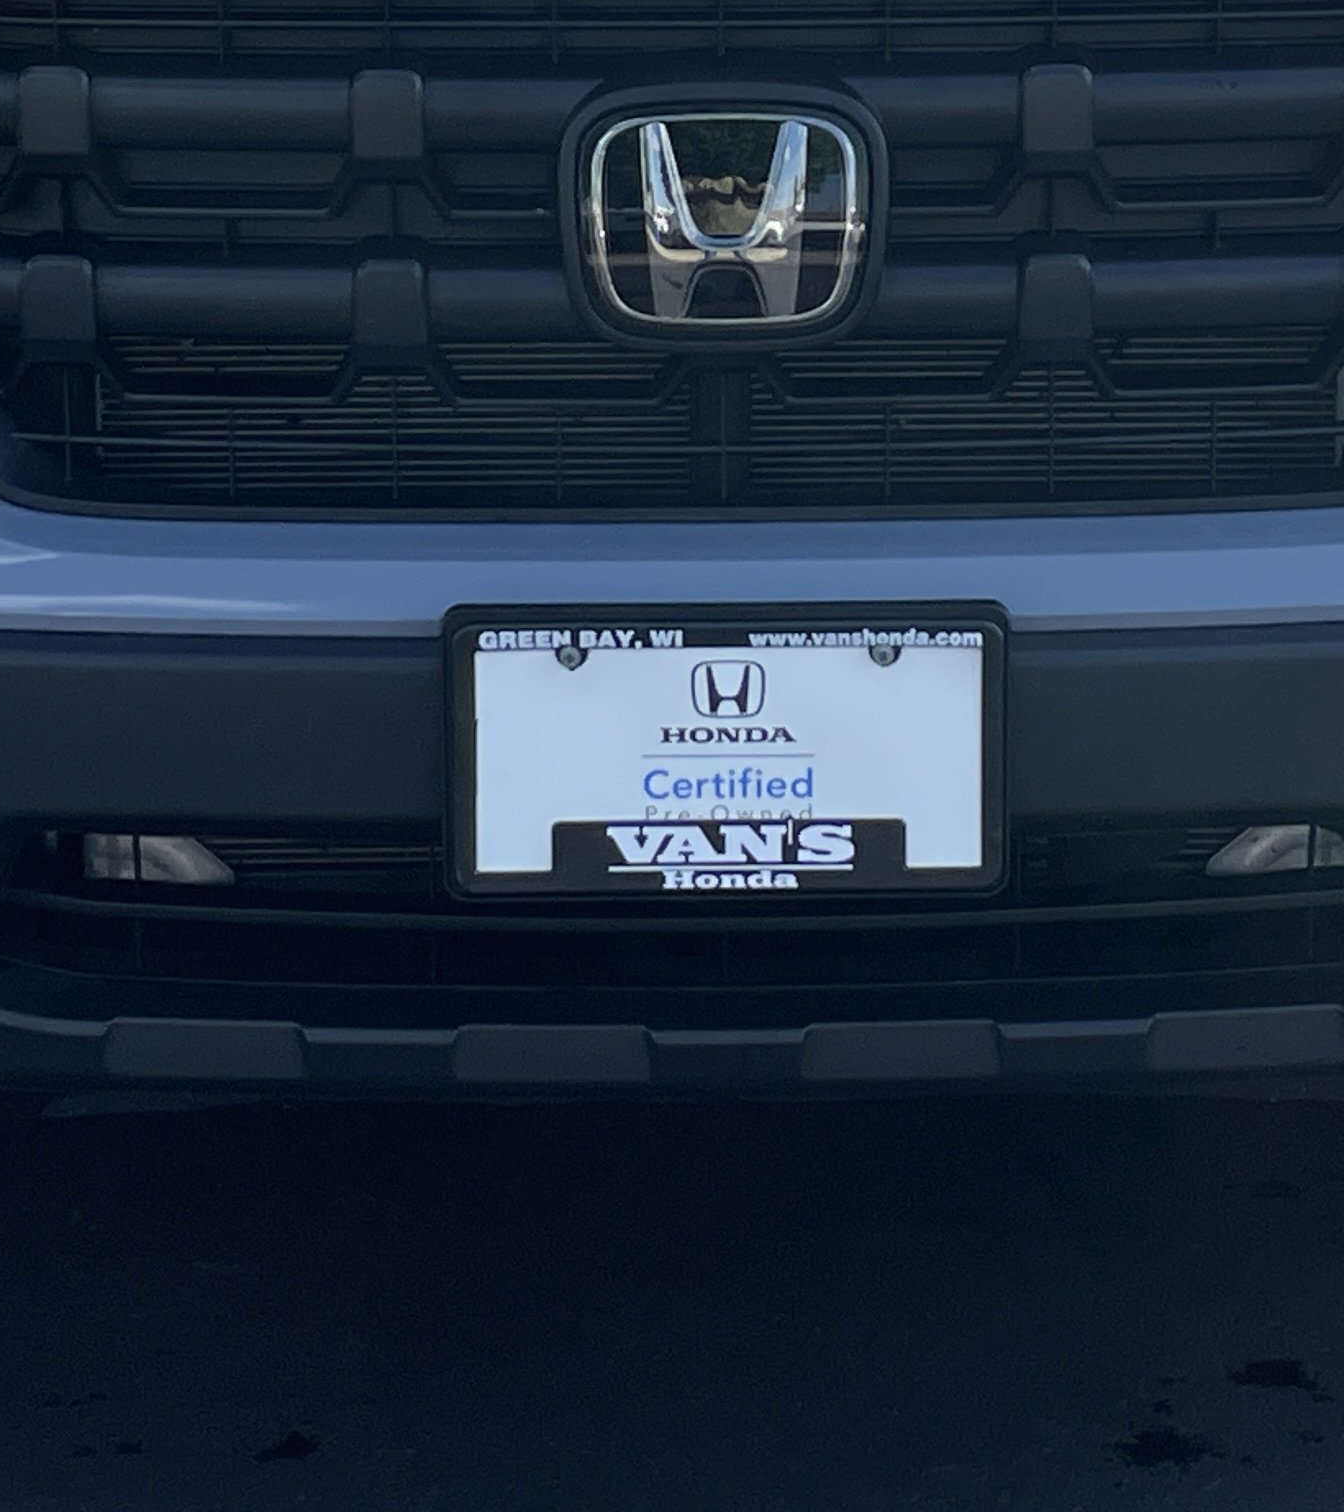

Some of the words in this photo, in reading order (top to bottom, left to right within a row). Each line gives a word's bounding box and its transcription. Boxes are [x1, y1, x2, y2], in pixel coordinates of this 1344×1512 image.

[478, 630, 572, 650] GREEN
[579, 629, 643, 650] BAY,
[649, 629, 684, 648] WI
[749, 628, 983, 647] www.vanshonda.com
[659, 727, 797, 744] HONDA
[642, 768, 814, 801] Certified
[607, 820, 855, 864] VAN'S
[662, 871, 799, 890] Honda
